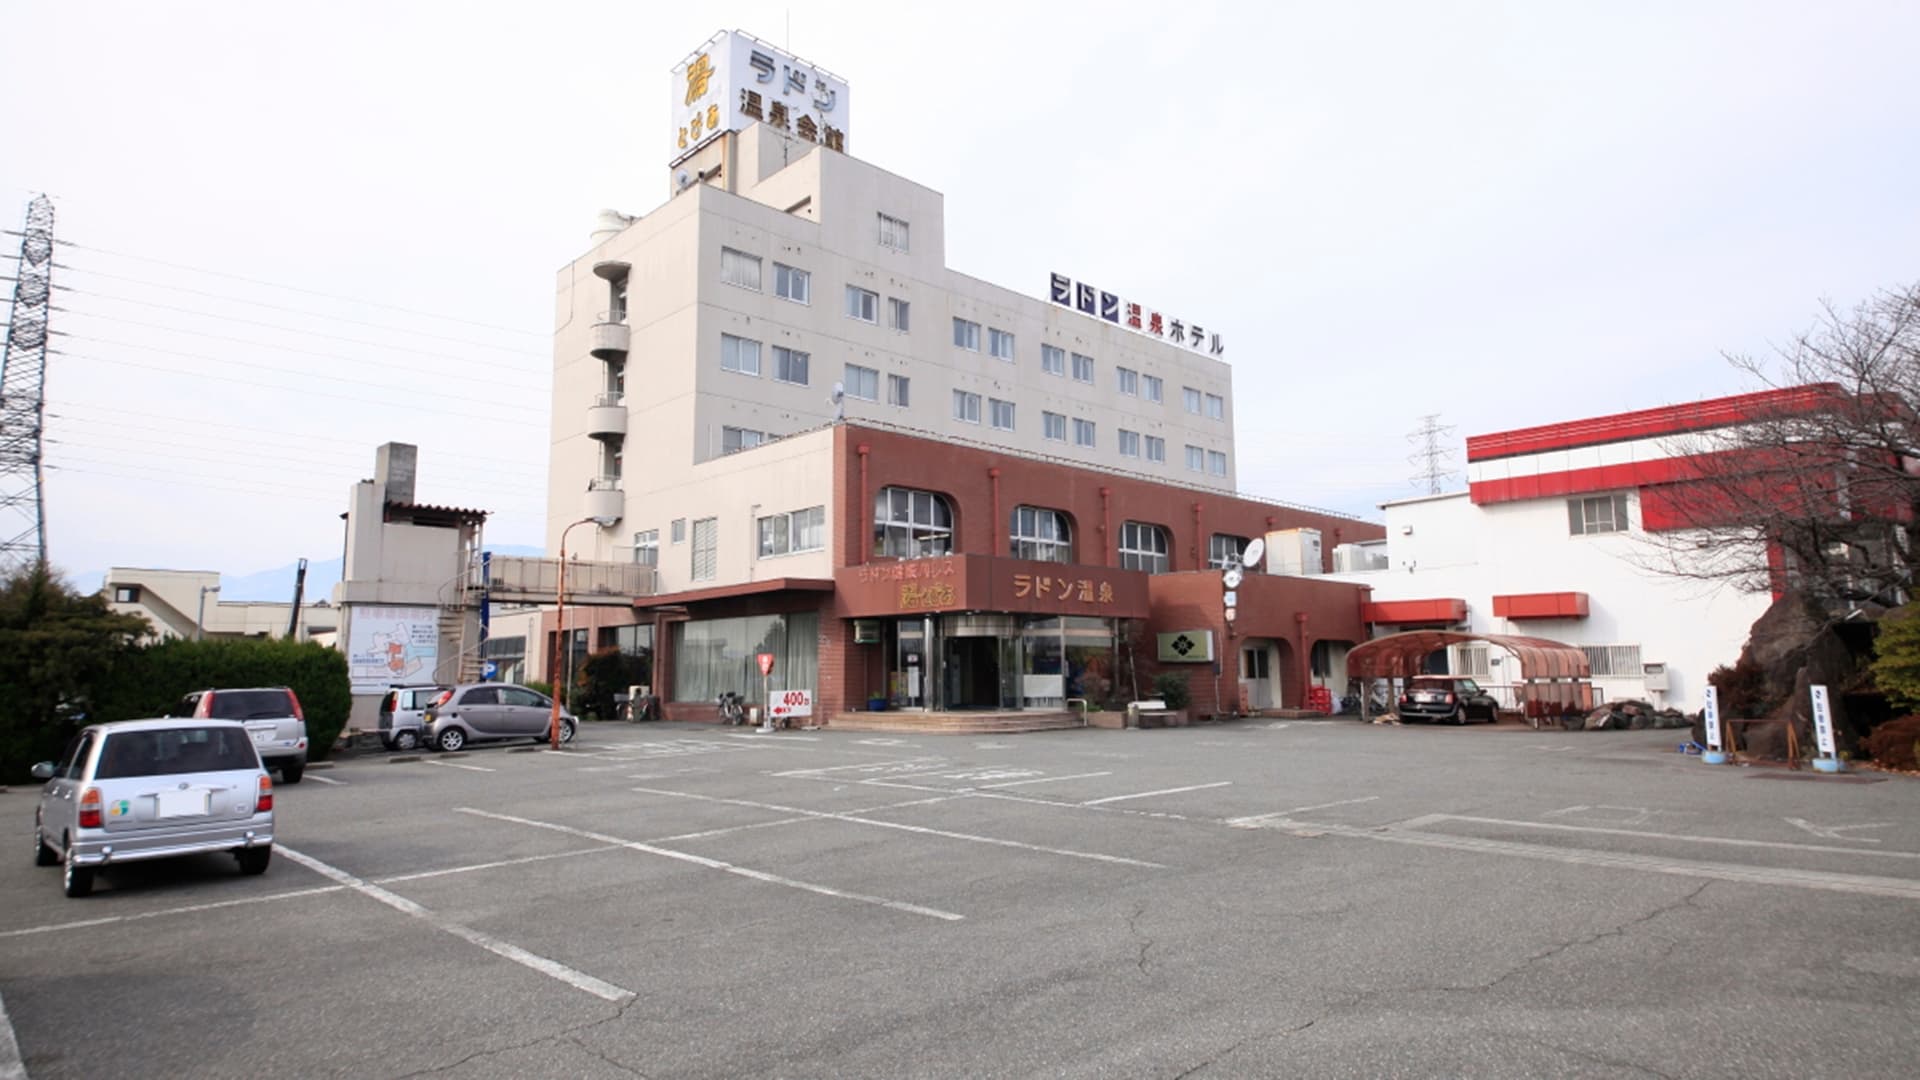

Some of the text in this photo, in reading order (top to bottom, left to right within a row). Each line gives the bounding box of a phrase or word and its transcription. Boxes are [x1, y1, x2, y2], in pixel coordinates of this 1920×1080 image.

[750, 49, 836, 112] ラドン
[1052, 273, 1224, 355] ラドン温泉ホテル
[1014, 575, 1113, 603] ラドン温泉
